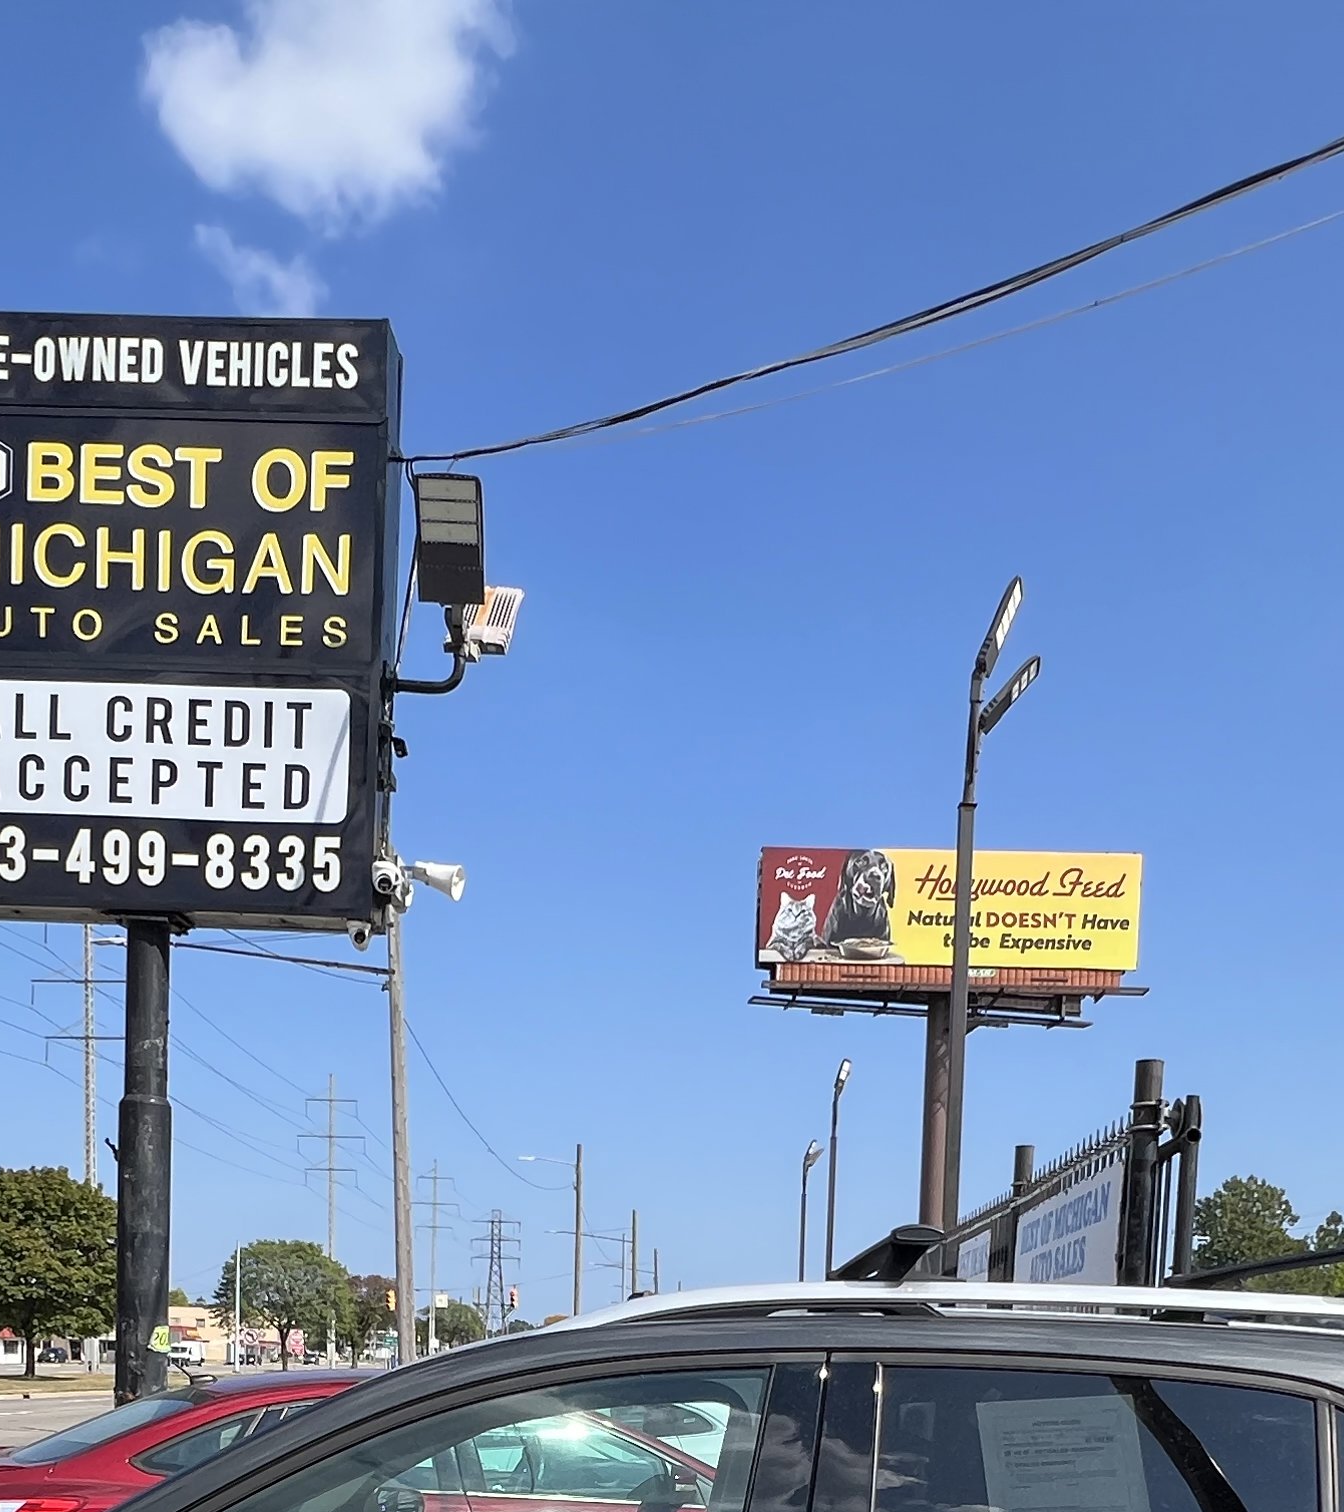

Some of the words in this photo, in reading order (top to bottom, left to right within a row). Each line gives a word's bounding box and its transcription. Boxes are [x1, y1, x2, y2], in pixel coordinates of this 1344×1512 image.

[179, 339, 359, 390] VEHICLES
[26, 441, 222, 509] BEST
[251, 450, 354, 512] OF
[154, 613, 348, 647] SALES
[106, 695, 312, 749] CREDIT
[915, 864, 1050, 901] Hoywood
[1053, 867, 1127, 898] Feed
[907, 910, 982, 926] Natul
[986, 911, 1077, 929] DOESN'T
[1081, 914, 1130, 930] Have
[969, 932, 990, 949] be
[999, 933, 1092, 953] Expensive
[1041, 1210, 1054, 1246] OF
[1053, 1181, 1111, 1241] MICHIGAN
[1030, 1249, 1052, 1282] AUTO
[1053, 1235, 1086, 1280] SALES
